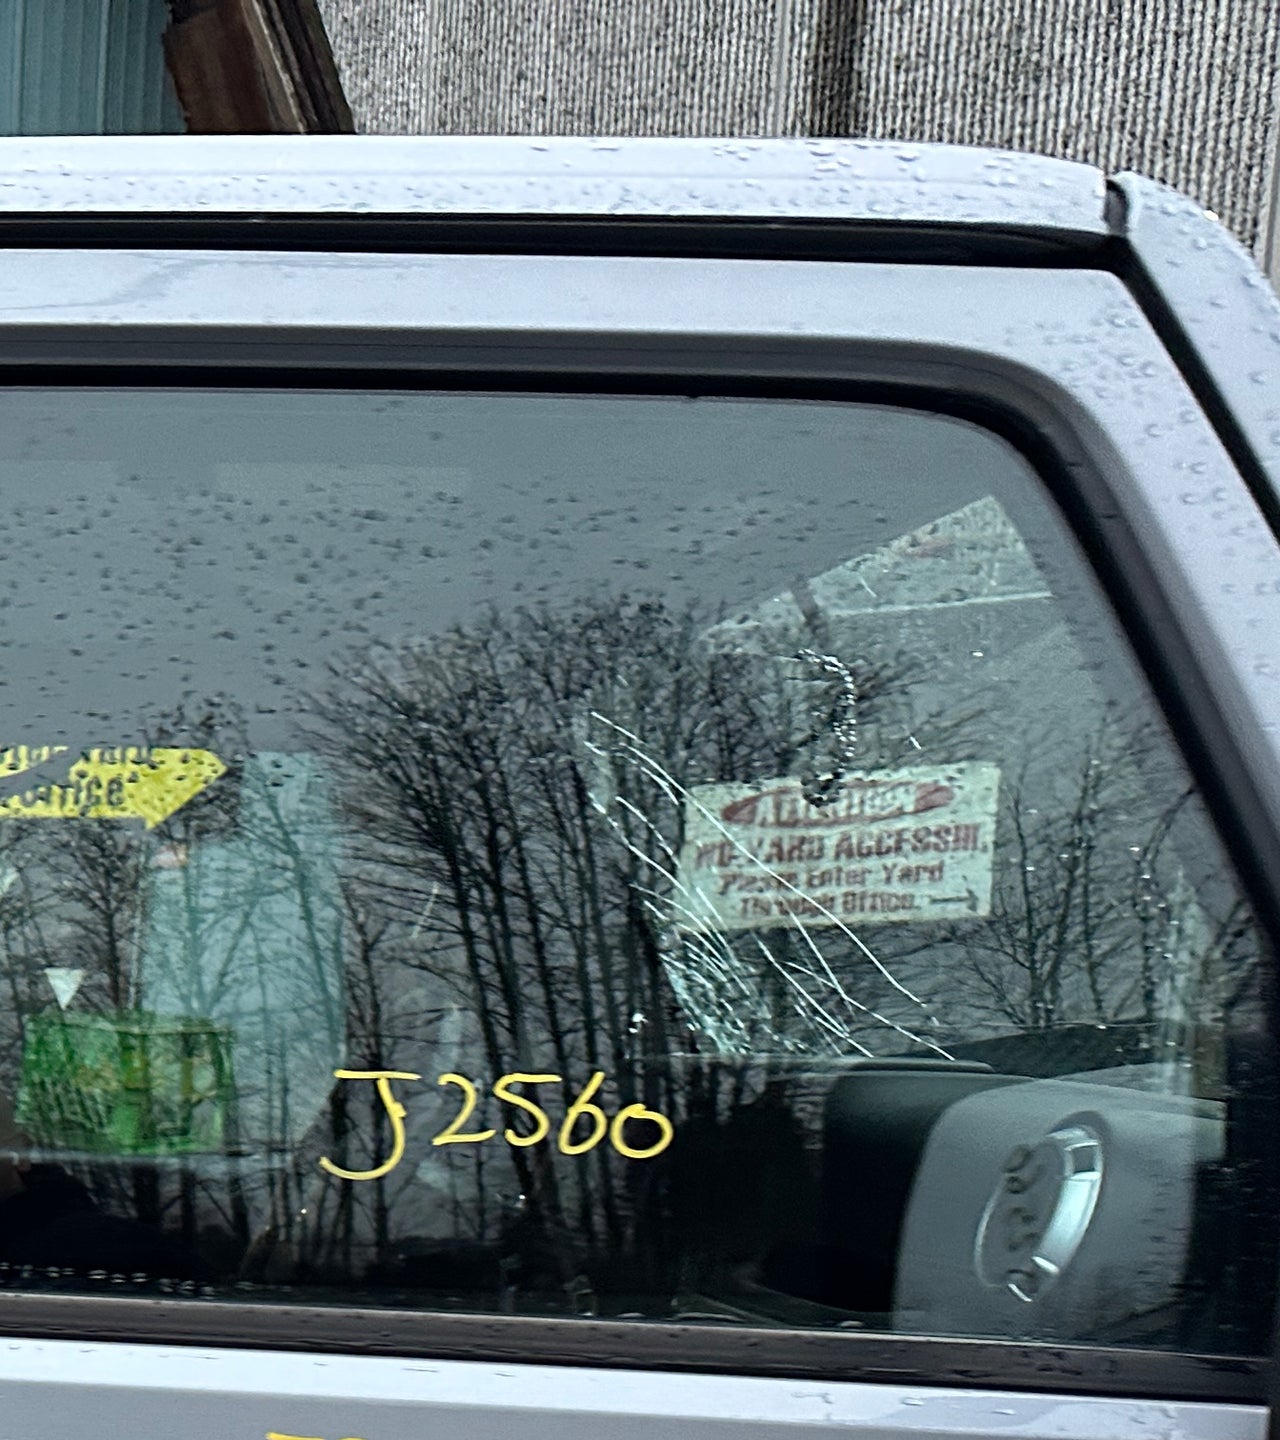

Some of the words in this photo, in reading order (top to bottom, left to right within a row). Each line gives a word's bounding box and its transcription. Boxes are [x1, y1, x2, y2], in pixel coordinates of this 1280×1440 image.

[806, 864, 872, 889] Enter
[883, 860, 945, 884] Yard
[319, 1069, 673, 1180] J2560
